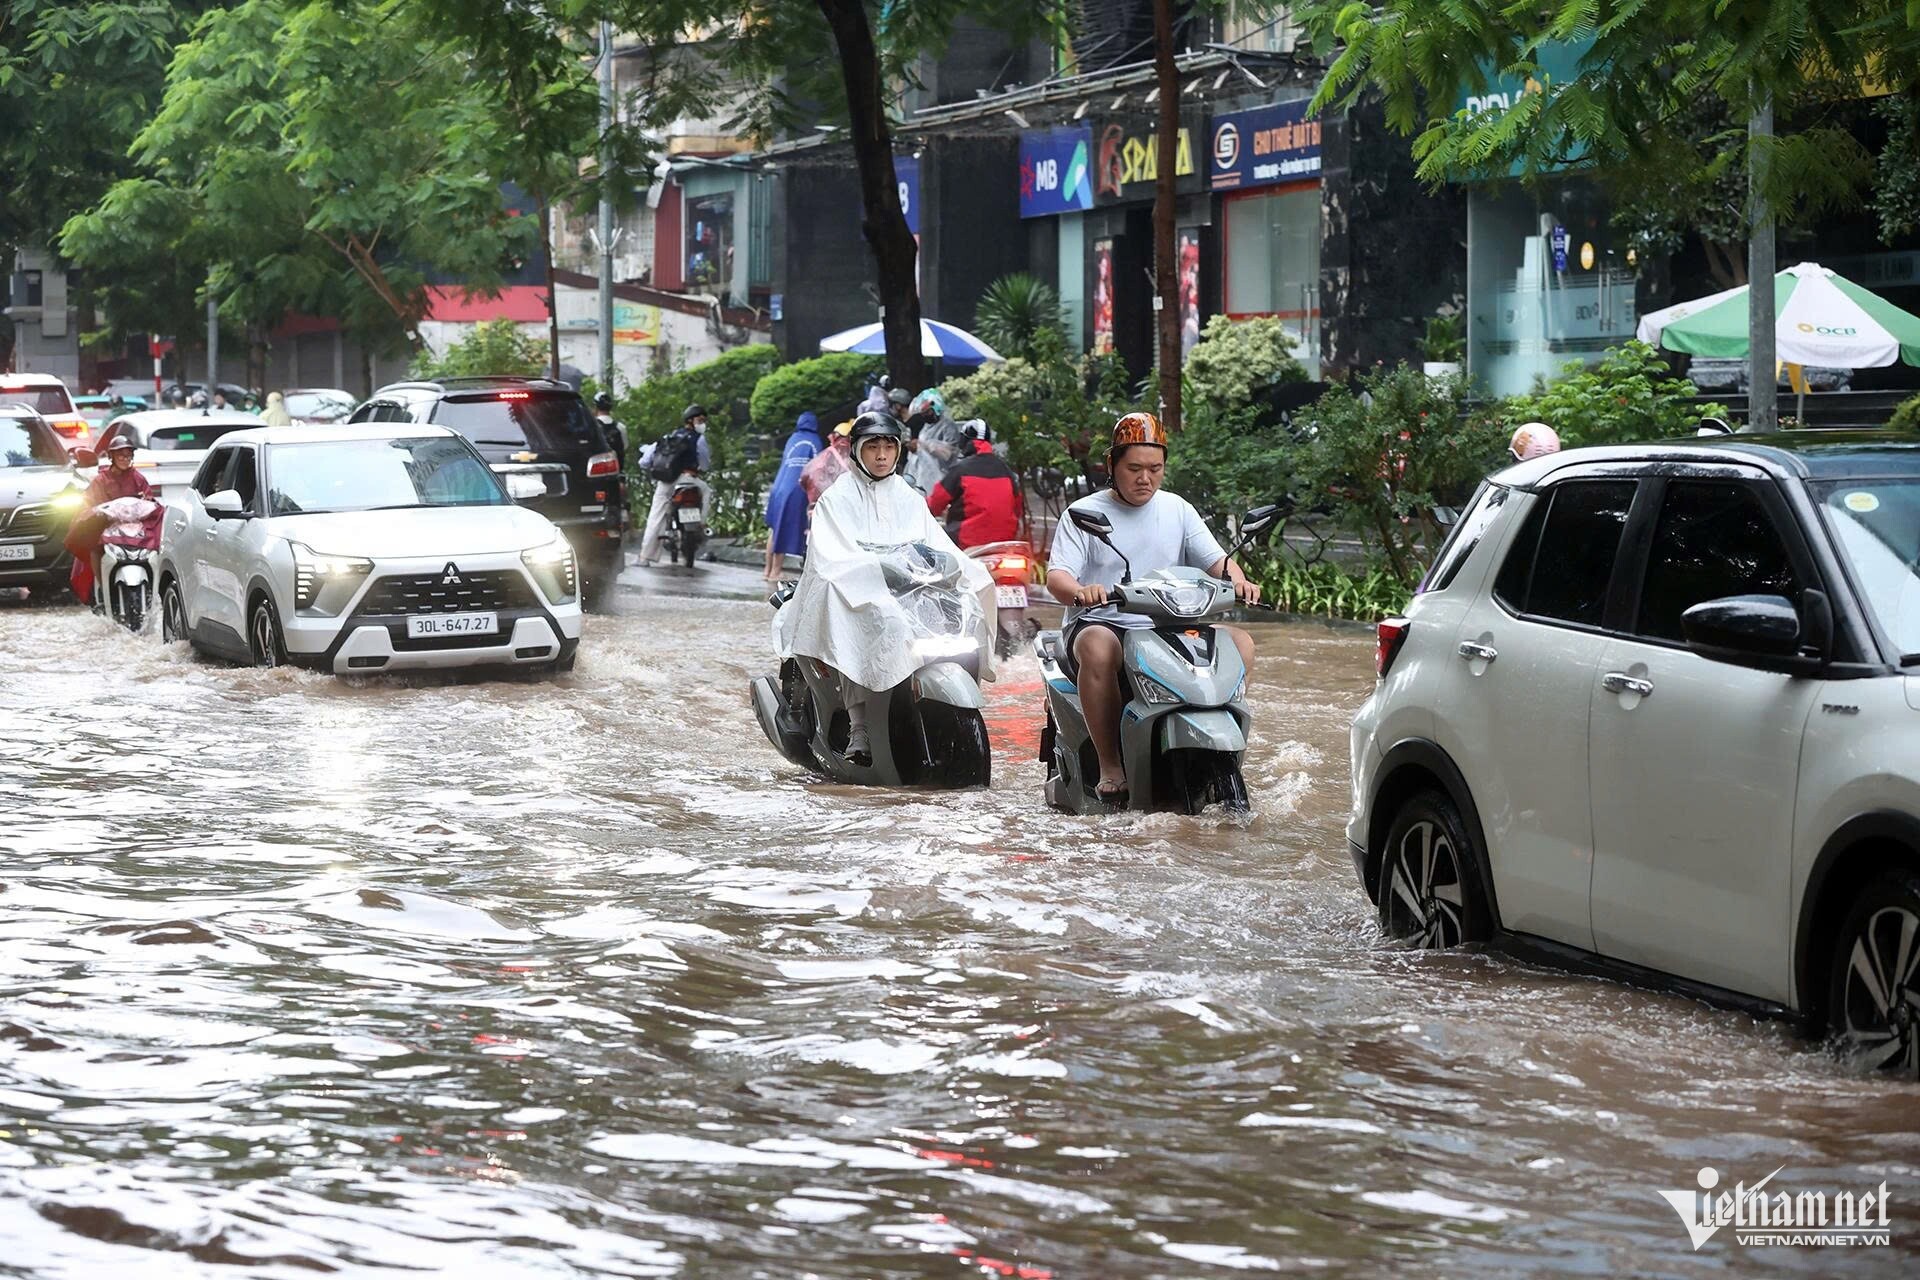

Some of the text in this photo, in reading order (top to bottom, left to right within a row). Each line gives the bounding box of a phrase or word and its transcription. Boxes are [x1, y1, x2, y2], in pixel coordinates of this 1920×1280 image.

[1120, 128, 1193, 184] SPAA
[1036, 159, 1058, 192] MB
[1816, 326, 1857, 336] OCB
[416, 617, 490, 634] 30L-647.27
